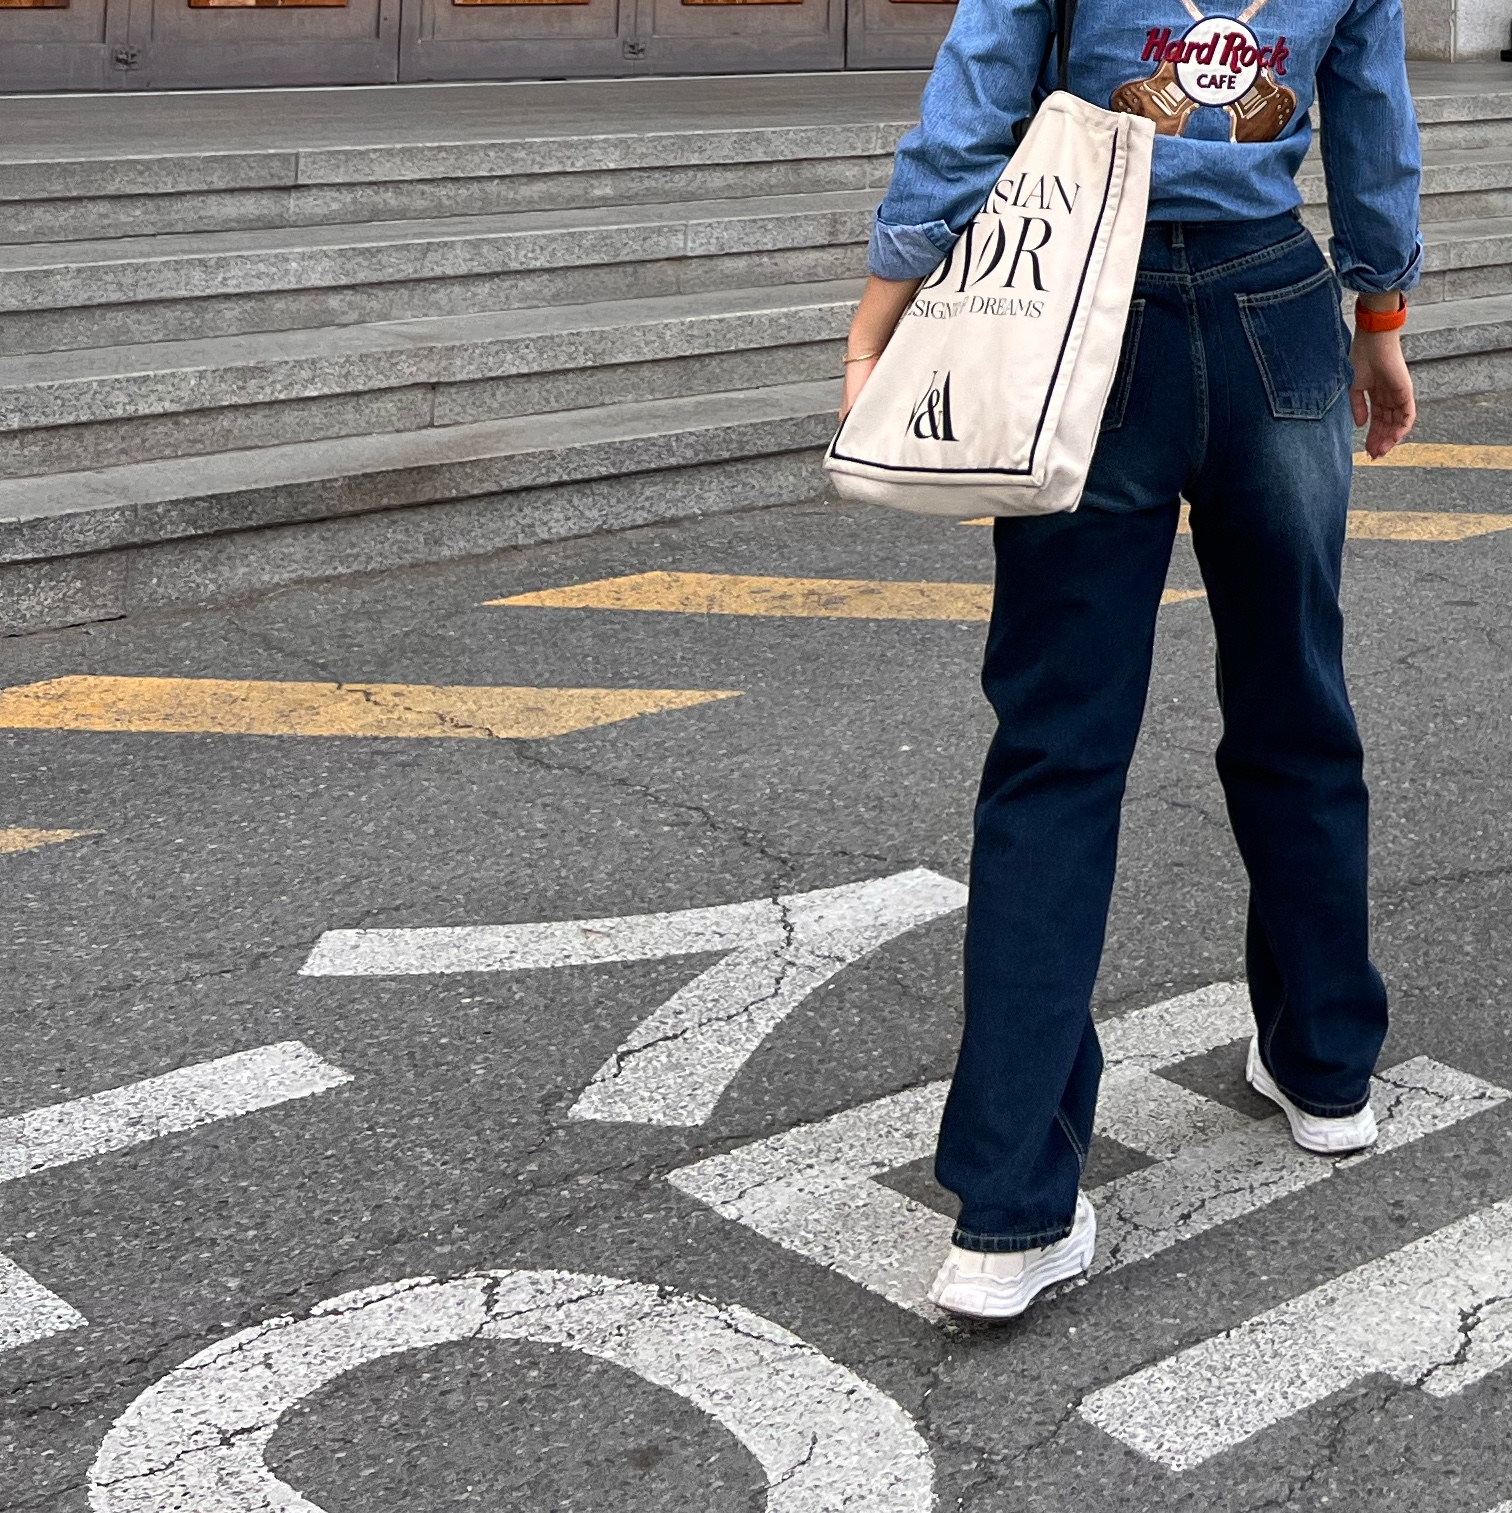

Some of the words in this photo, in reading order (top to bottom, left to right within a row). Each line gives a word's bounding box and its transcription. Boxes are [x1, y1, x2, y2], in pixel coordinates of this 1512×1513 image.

[1140, 27, 1221, 64] Hard
[1219, 31, 1290, 75] Rock
[1196, 73, 1236, 90] CAFE
[968, 295, 1045, 319] DREAMS
